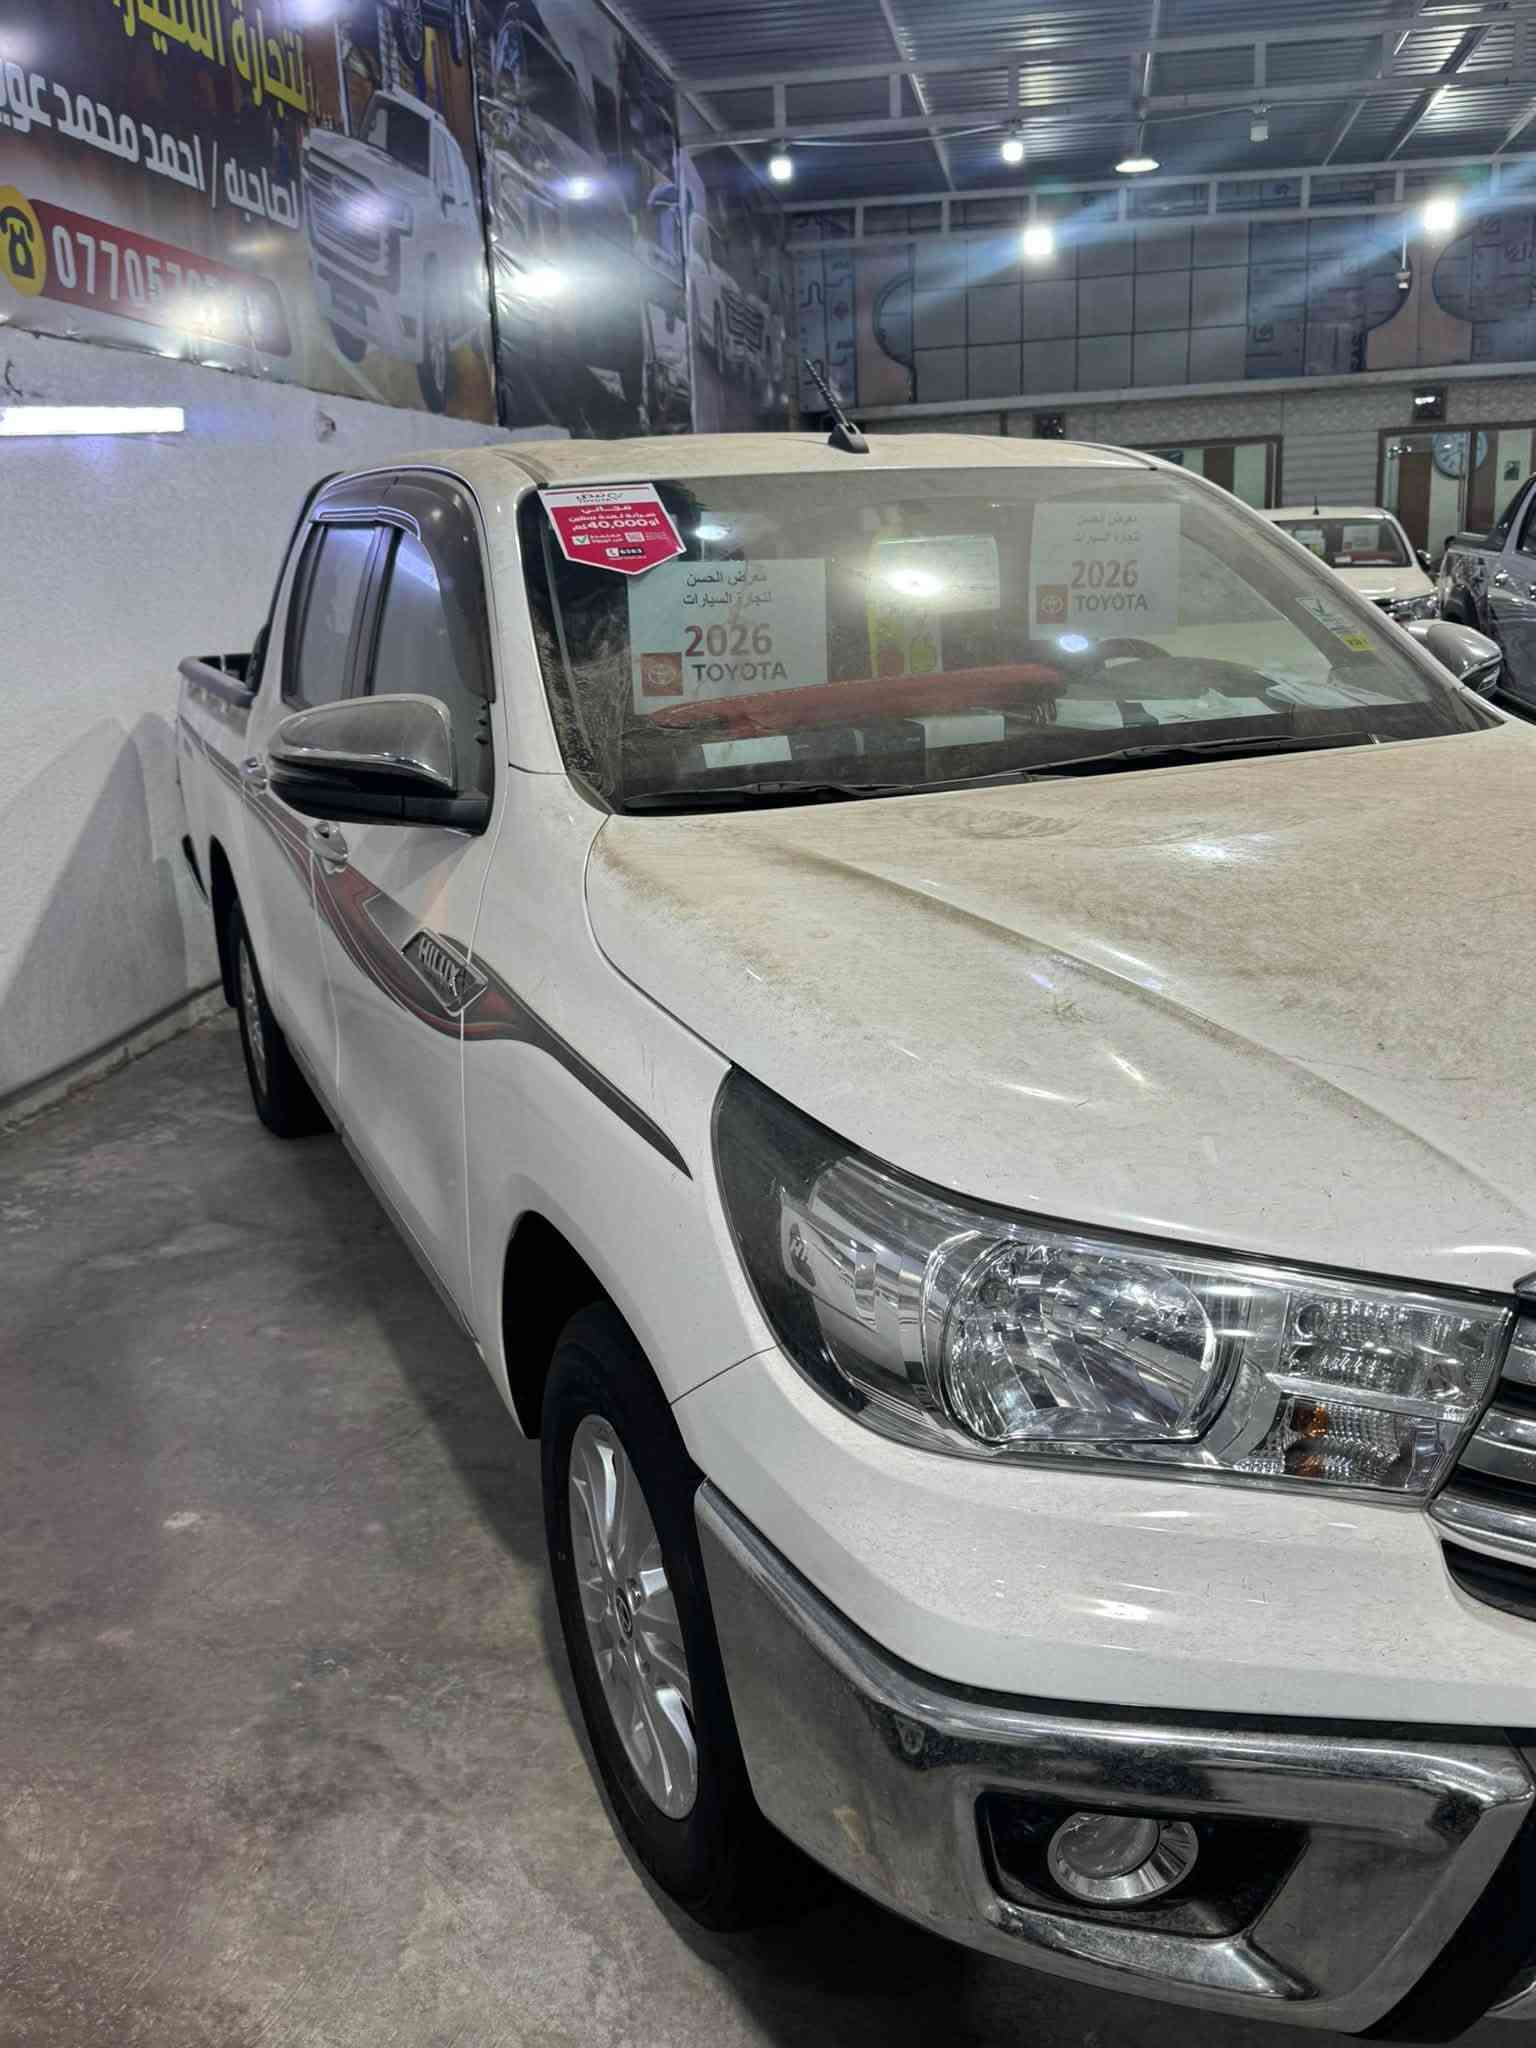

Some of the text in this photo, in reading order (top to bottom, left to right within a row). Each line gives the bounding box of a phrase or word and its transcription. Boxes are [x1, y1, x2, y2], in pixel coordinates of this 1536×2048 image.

[53, 82, 139, 164] محمد
[142, 123, 206, 192] احمد
[686, 569, 723, 588] الحسن
[1071, 559, 1138, 589] 2026
[682, 591, 733, 610] السيارات
[1072, 592, 1149, 612] TOYOTA
[684, 623, 773, 658] 2026
[691, 661, 789, 683] TOYOTA
[418, 936, 461, 998] HILUX
